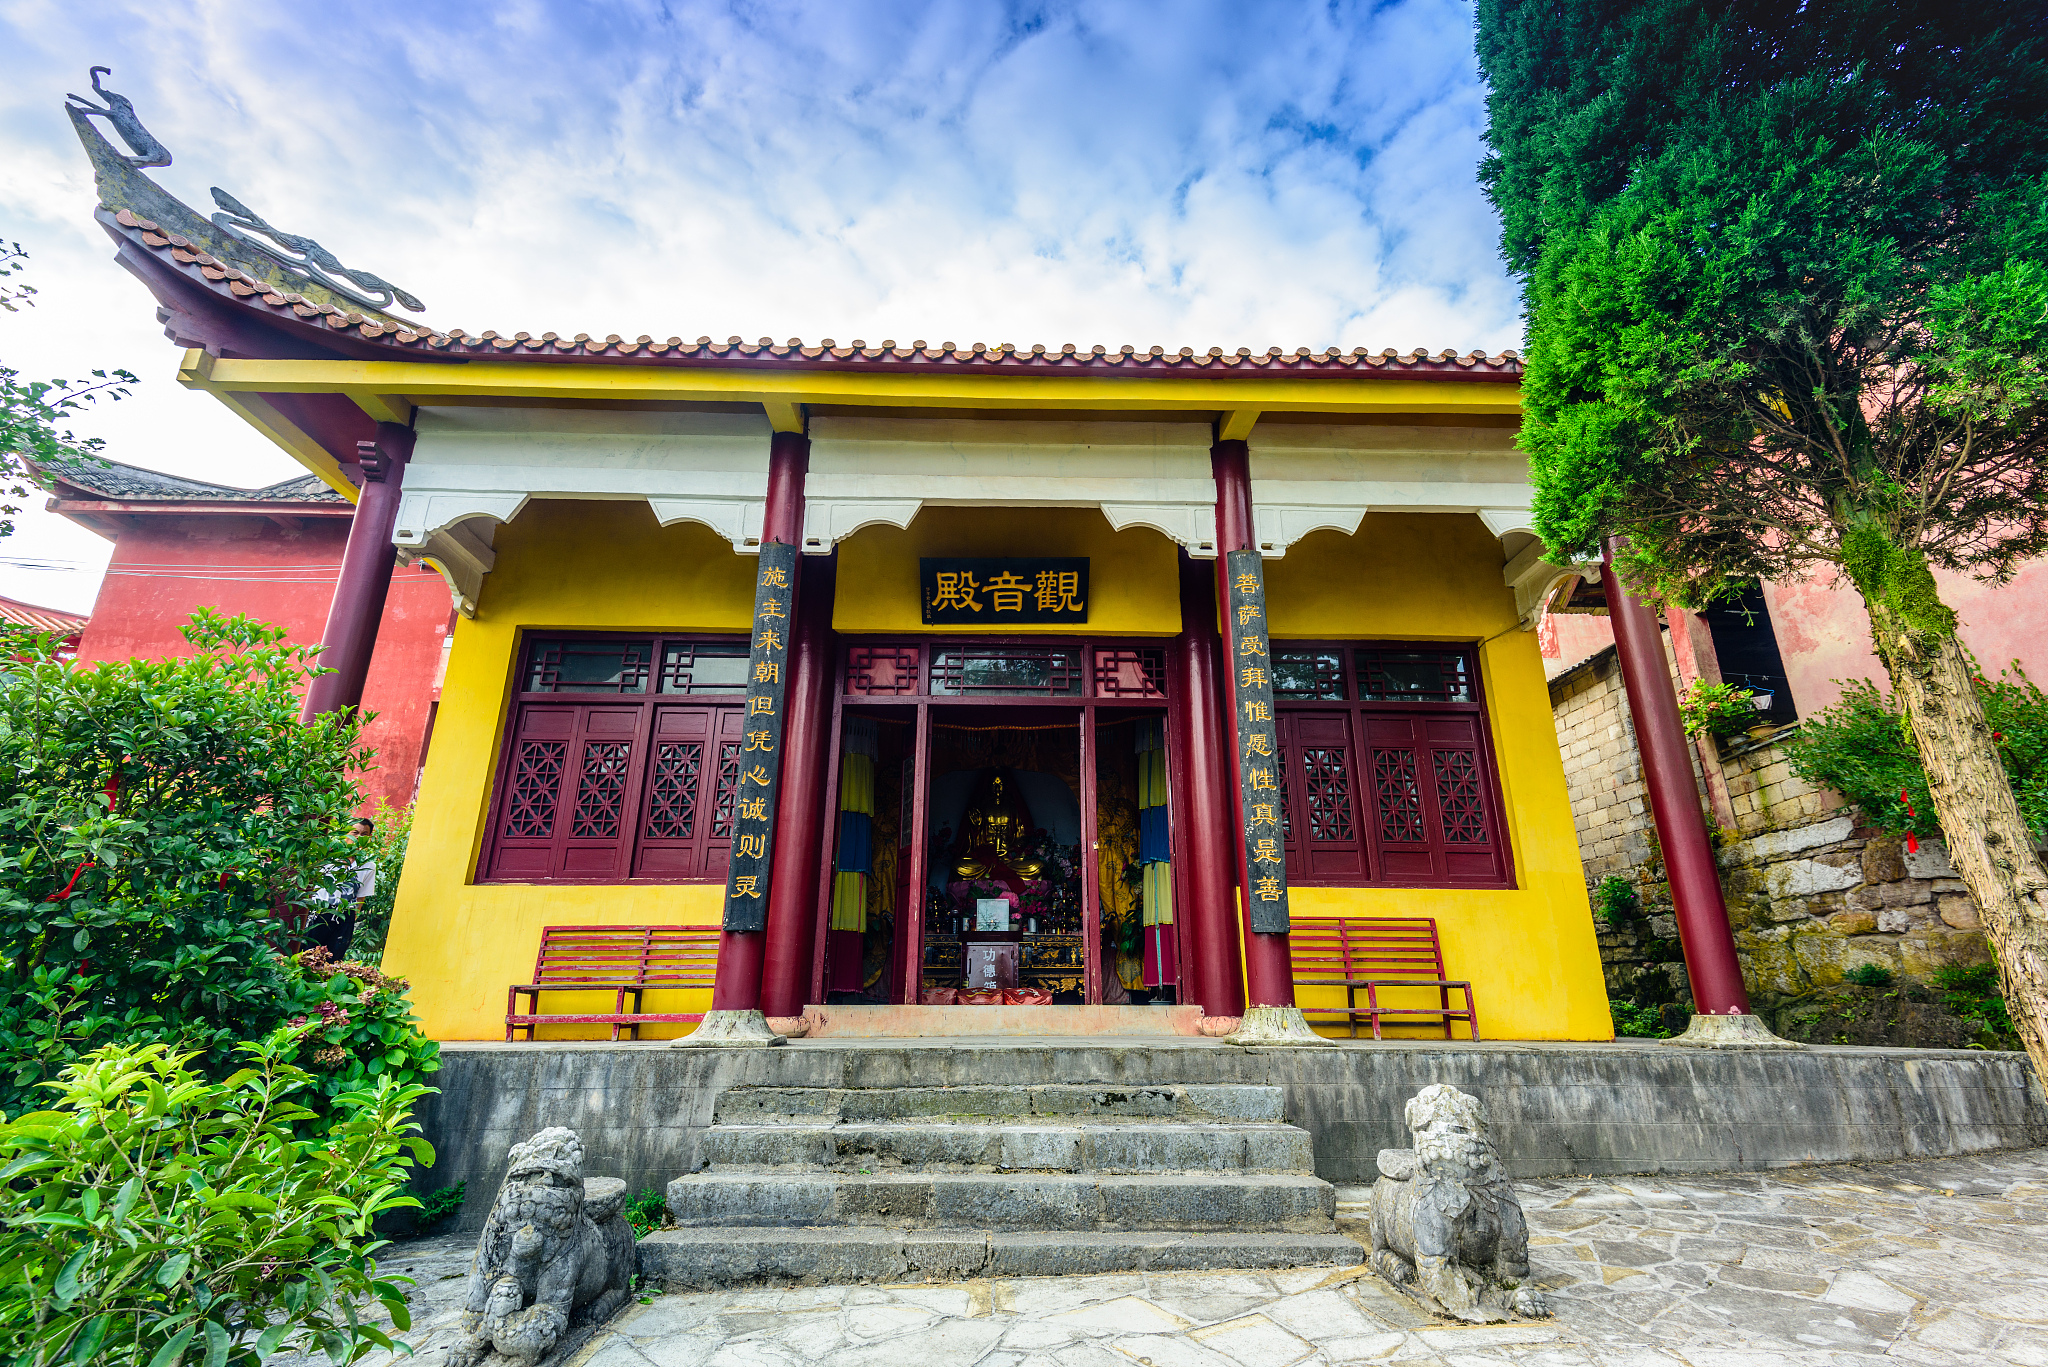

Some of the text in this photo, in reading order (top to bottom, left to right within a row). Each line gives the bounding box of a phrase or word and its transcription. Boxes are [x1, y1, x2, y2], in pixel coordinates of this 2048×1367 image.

[730, 566, 789, 899] 施主来朝但凭心诚则灵
[931, 570, 1084, 613] 觀音殿
[1234, 573, 1284, 902] 菩萨受拜惟愿性真是善
